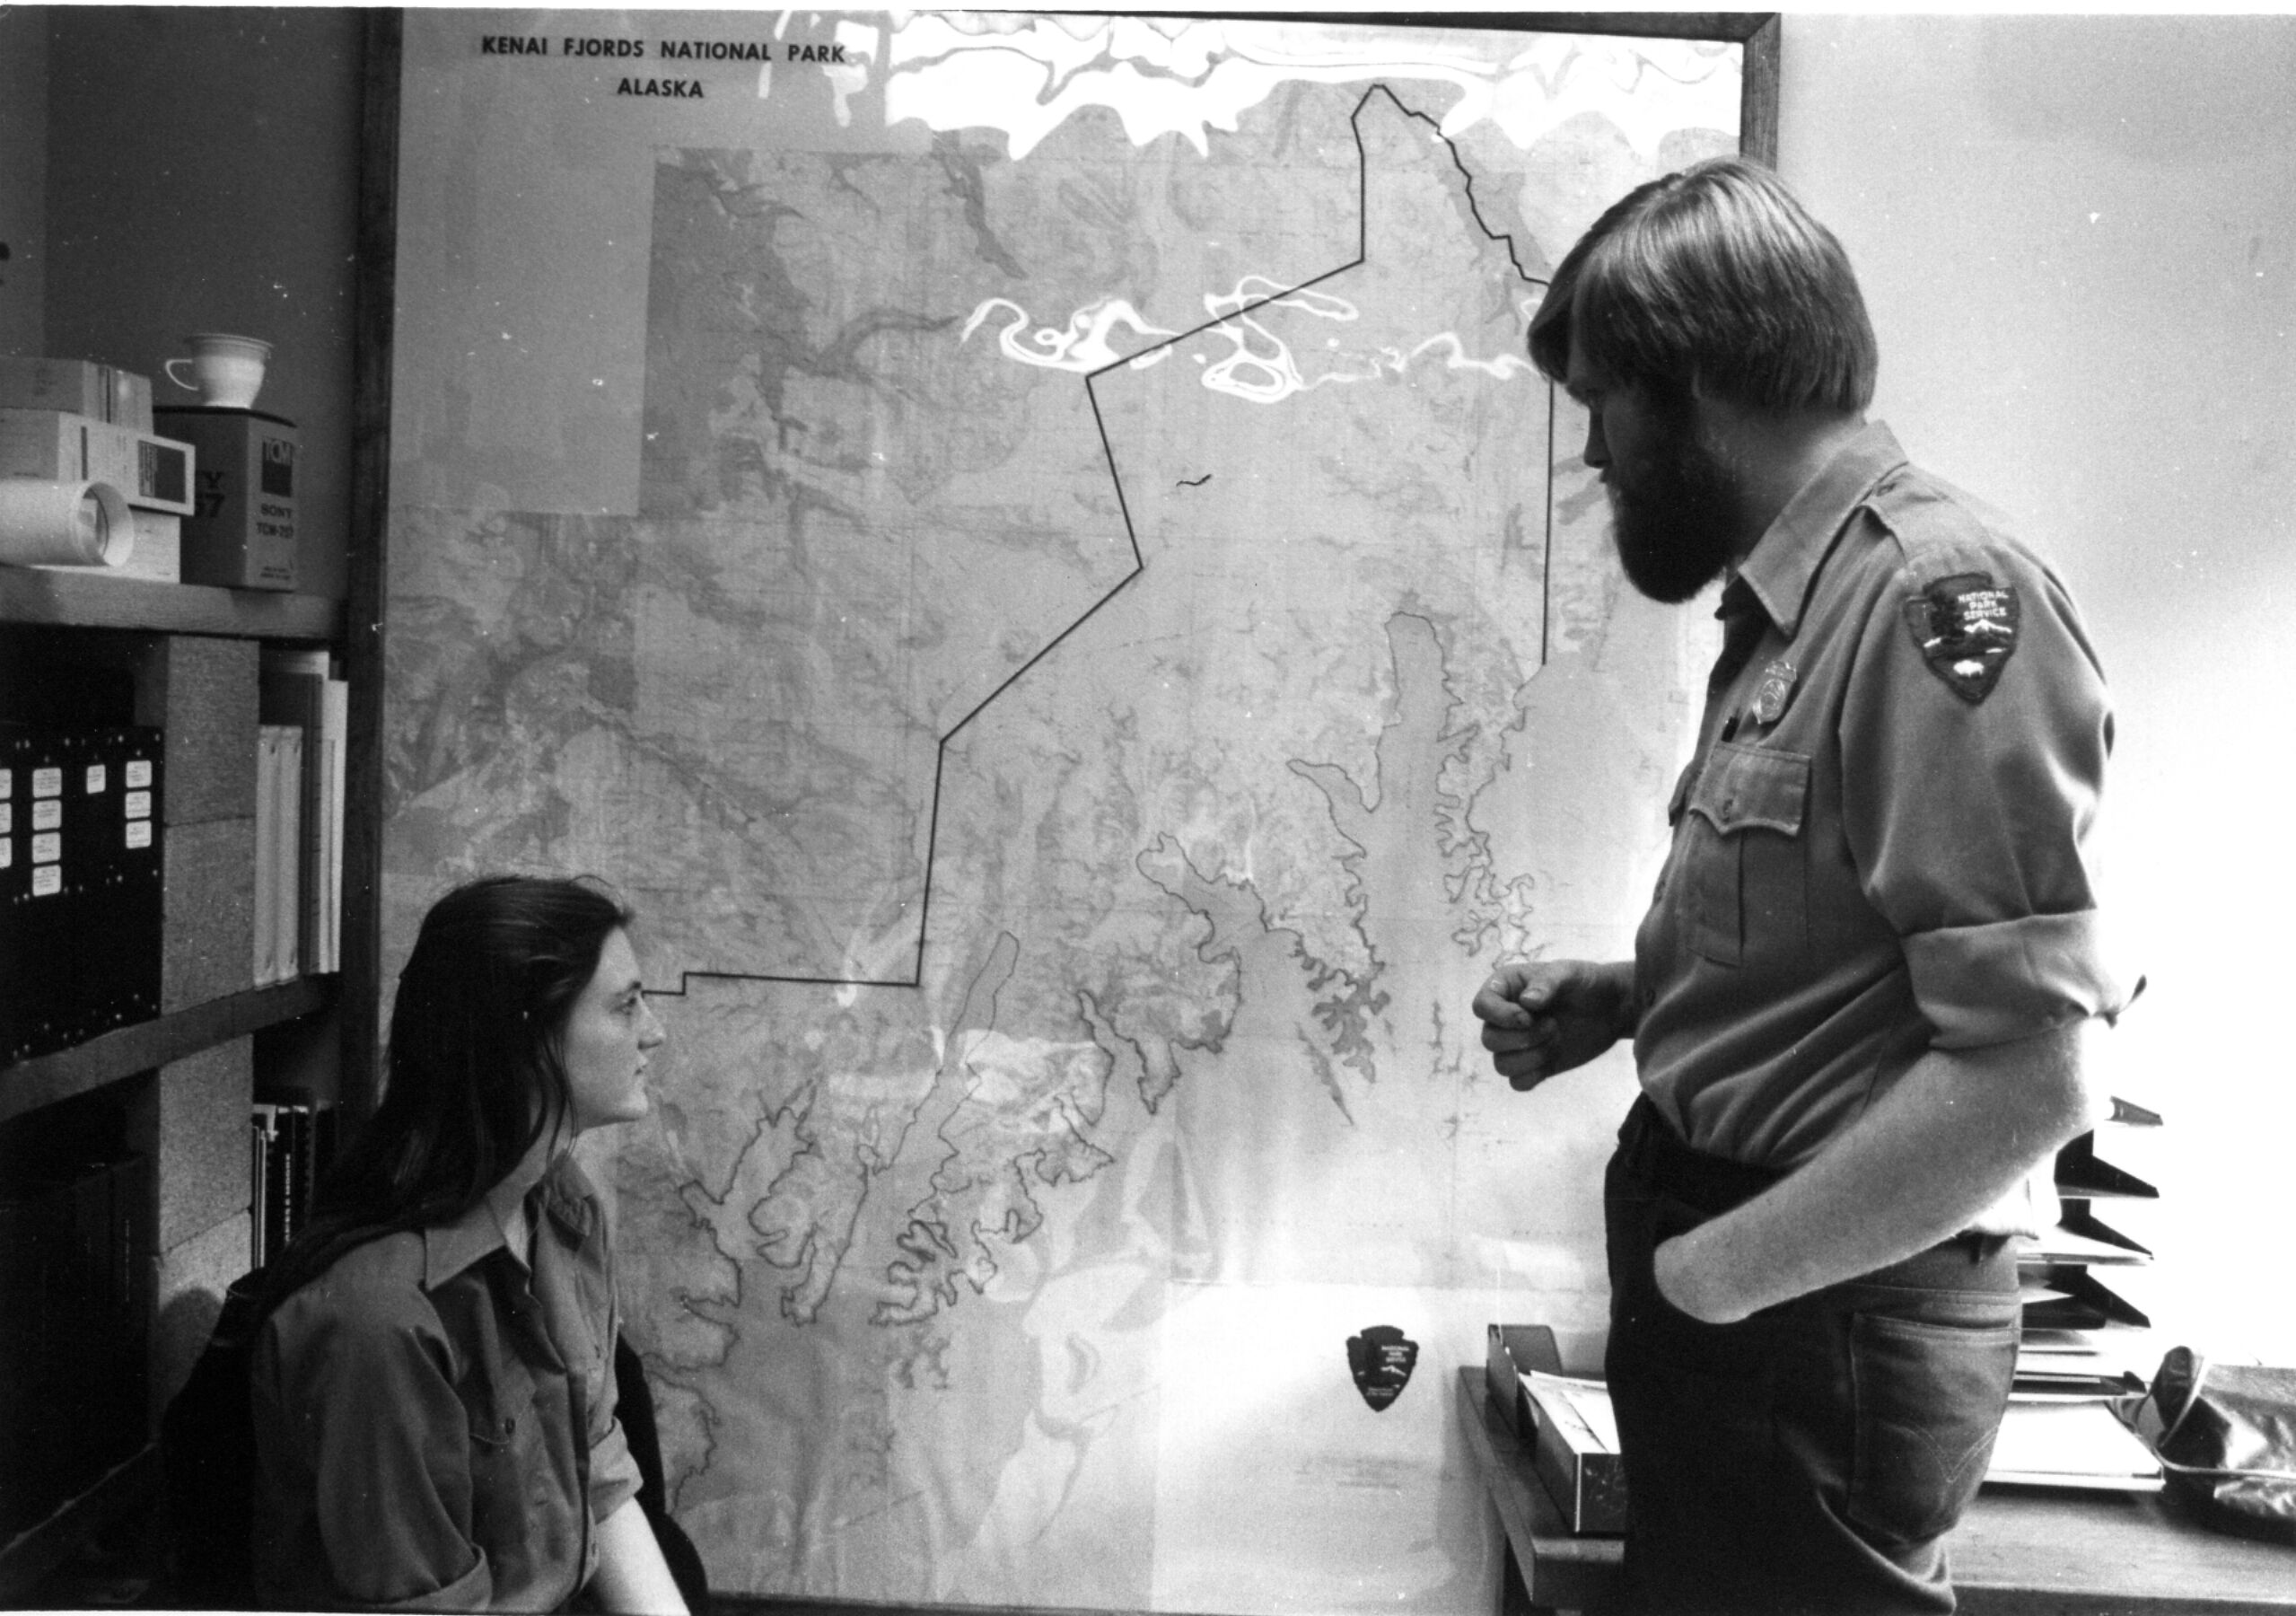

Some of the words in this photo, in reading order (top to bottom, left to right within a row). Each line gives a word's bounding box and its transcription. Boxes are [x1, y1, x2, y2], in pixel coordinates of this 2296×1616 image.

[481, 35, 548, 56] KENAI
[564, 38, 644, 57] FJORDS
[661, 40, 771, 61] NATIONAL
[788, 44, 845, 63] PARK
[617, 77, 704, 99] ALASKA
[1958, 591, 2010, 604] NATIONAL
[1968, 600, 1998, 610] PARK
[1963, 606, 2008, 621] SERVICE
